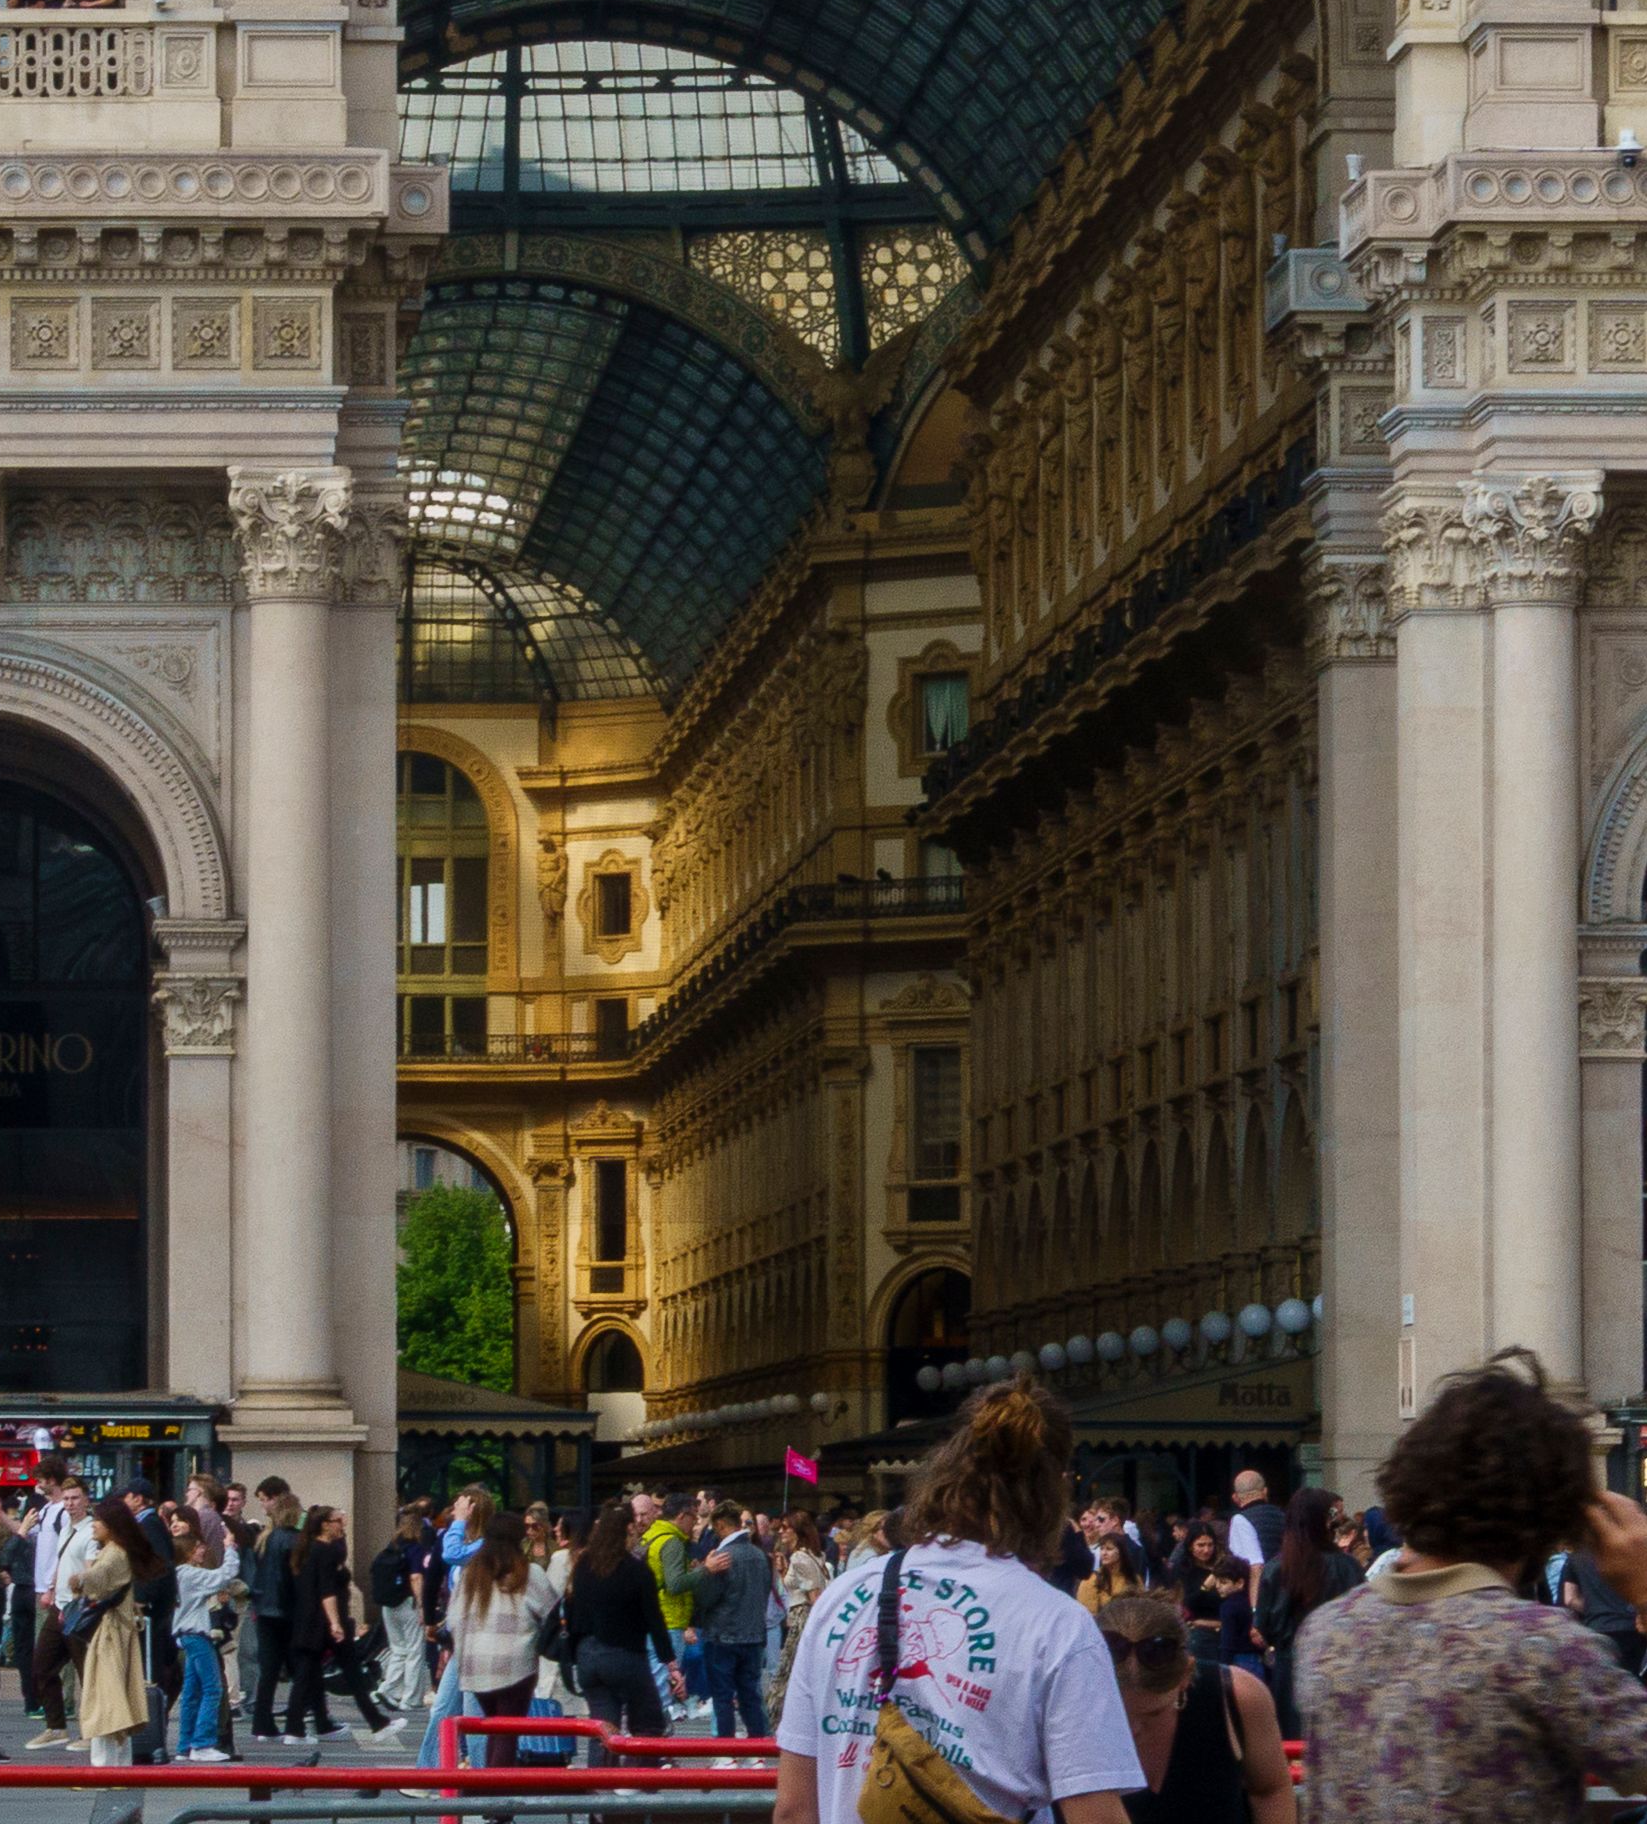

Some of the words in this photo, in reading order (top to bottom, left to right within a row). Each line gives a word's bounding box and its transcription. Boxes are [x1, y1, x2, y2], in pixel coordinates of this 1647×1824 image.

[1218, 1382, 1291, 1407] Motta
[826, 1582, 875, 1649] THE
[934, 1577, 997, 1675] STORE
